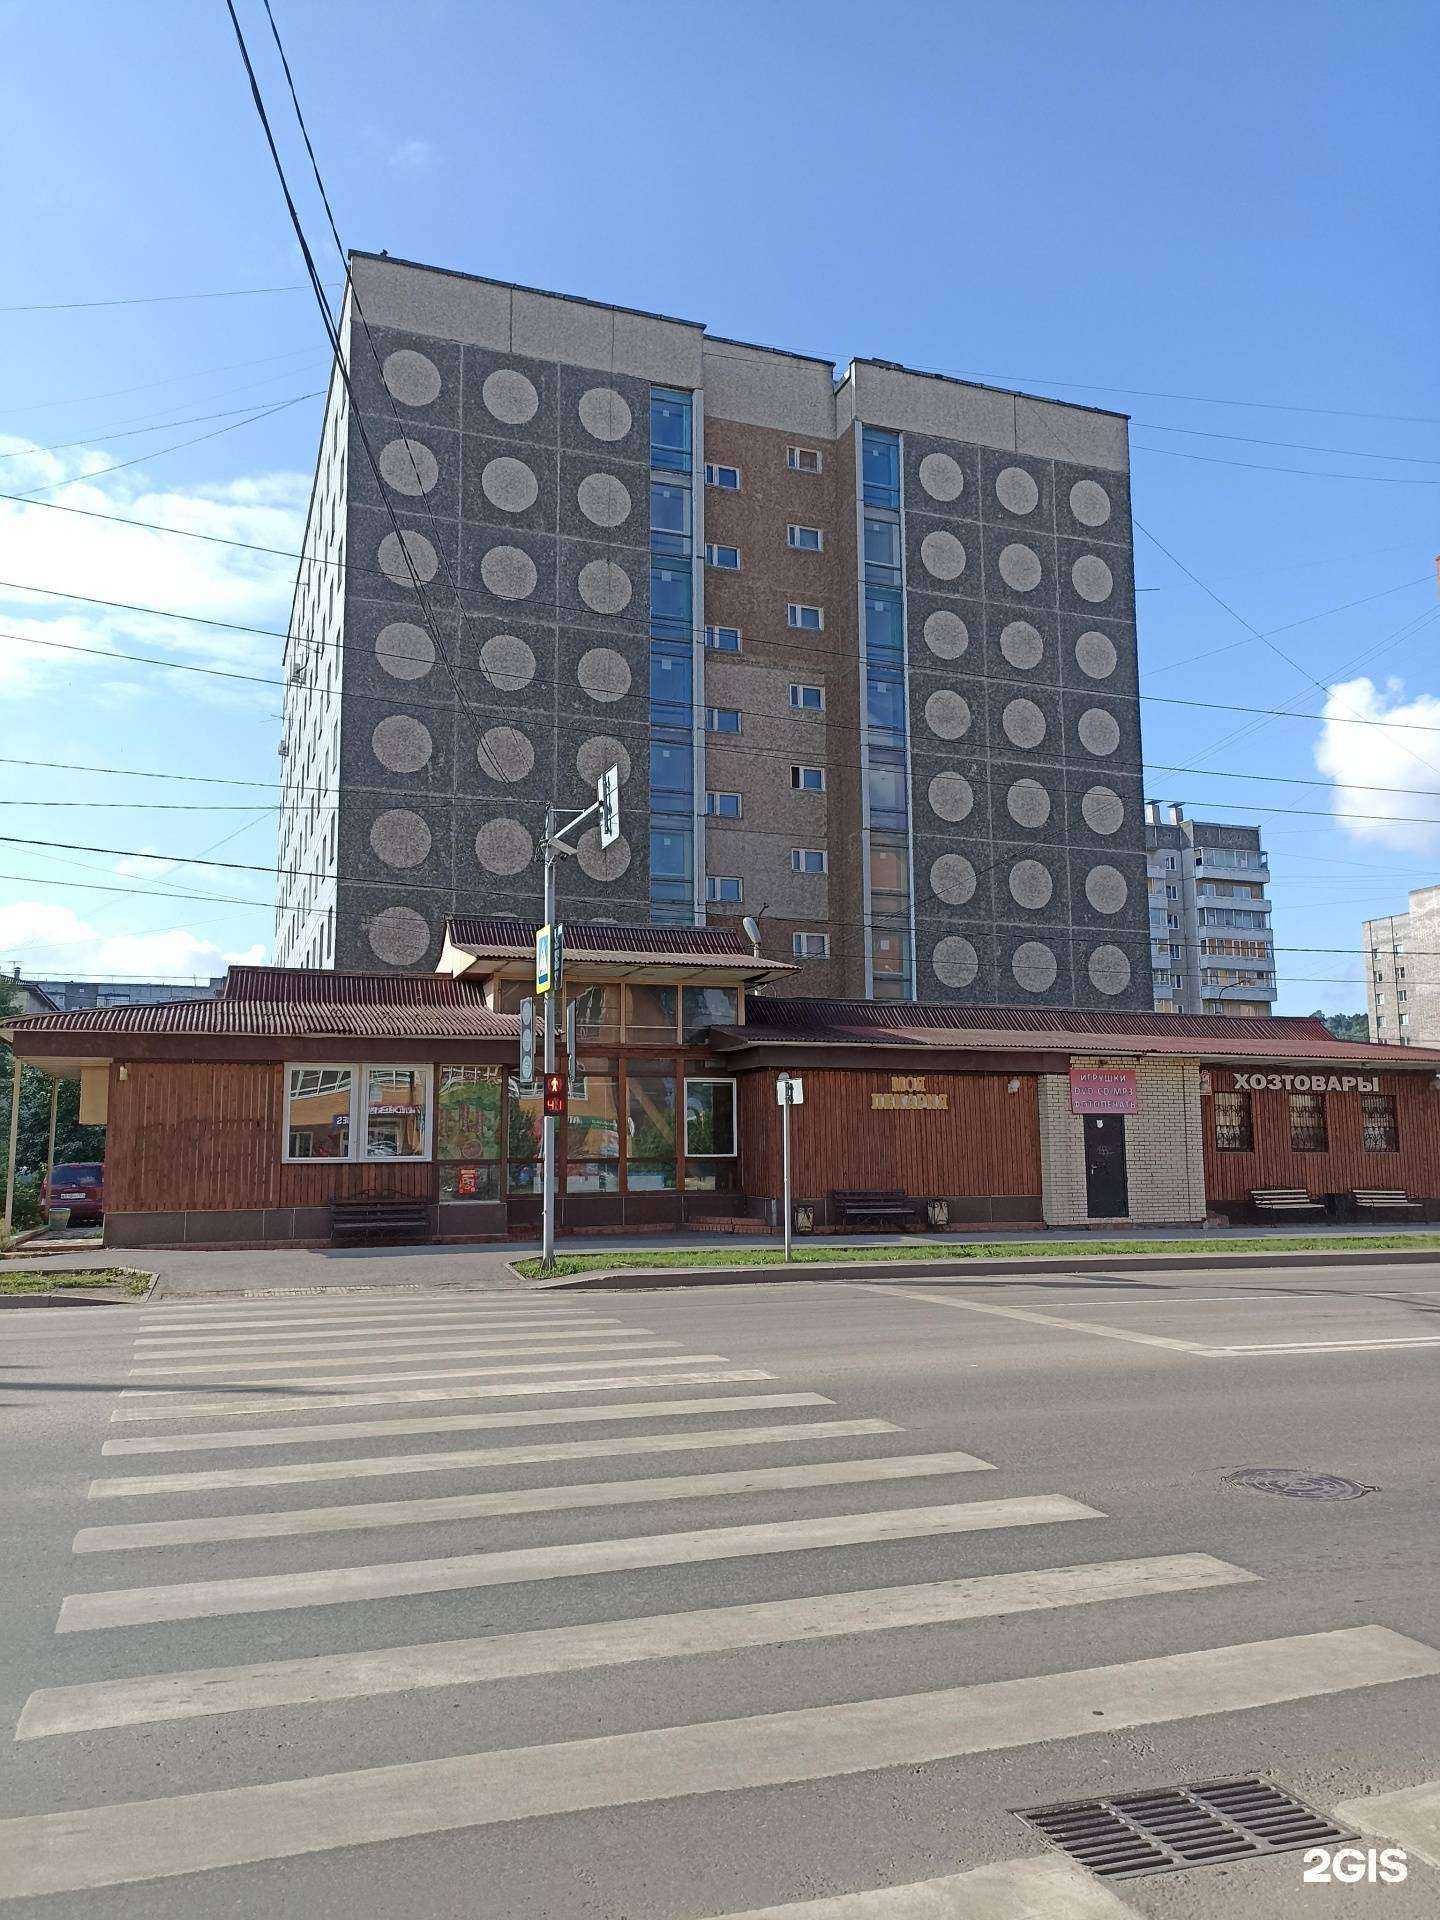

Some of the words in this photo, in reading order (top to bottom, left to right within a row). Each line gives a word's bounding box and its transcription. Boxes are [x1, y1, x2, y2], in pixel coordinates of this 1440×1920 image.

[1080, 1074, 1126, 1083] ИГРУШКИ
[1233, 1072, 1380, 1092] ХОЗТОВАРЫ
[891, 1076, 926, 1092] МОЯ
[1074, 1087, 1094, 1096] DVD
[1074, 1100, 1136, 1109] ФОТОПЕЧАТЬ
